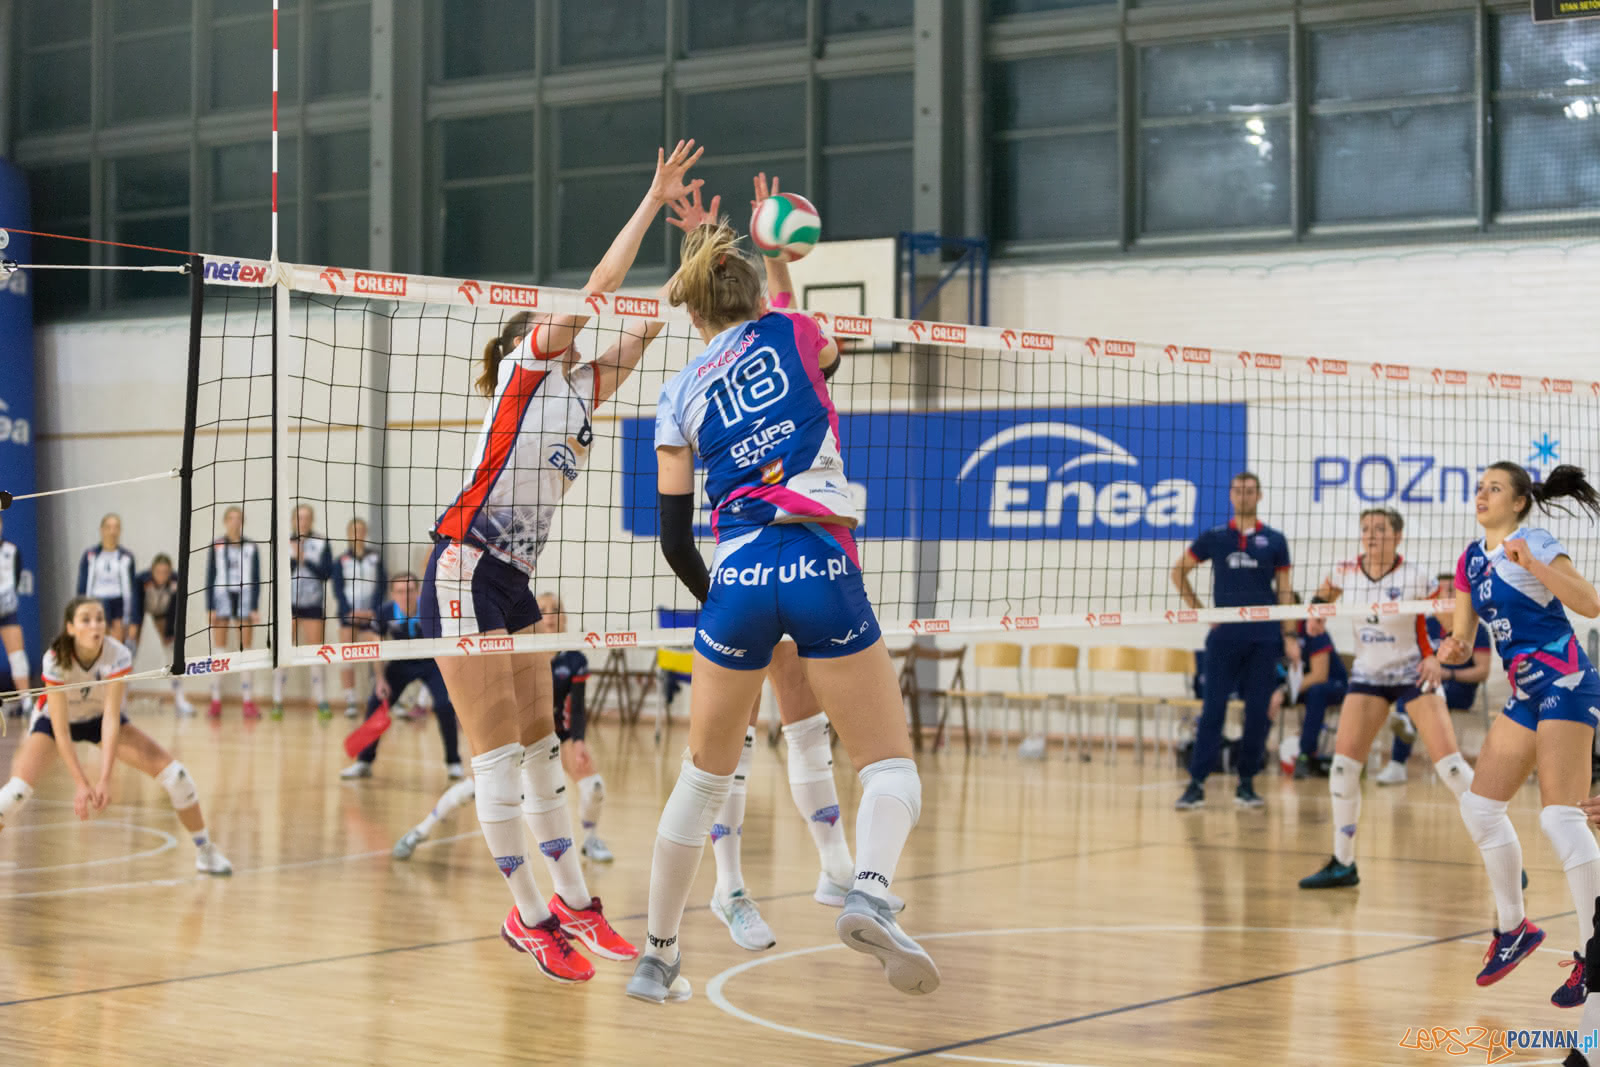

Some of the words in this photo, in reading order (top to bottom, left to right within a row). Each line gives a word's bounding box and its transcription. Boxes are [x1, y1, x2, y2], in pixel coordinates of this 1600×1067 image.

[203, 260, 267, 284] netex
[356, 274, 404, 293] ORLEN
[492, 287, 536, 305] ORLEN
[616, 298, 657, 315] ORLEN
[836, 317, 870, 335] ORLEN
[932, 325, 965, 342] ORLEN
[1022, 334, 1052, 348] ORLEN
[1106, 342, 1134, 355] ORLEN
[705, 345, 790, 429] 18
[548, 451, 578, 481] Enea
[988, 465, 1197, 528] Enea
[1477, 578, 1493, 602] 13
[449, 600, 462, 618] 8
[480, 639, 513, 650] ORLEN
[606, 633, 636, 646] ORLEN
[343, 645, 377, 659] ORLEN
[186, 657, 231, 675] netex
